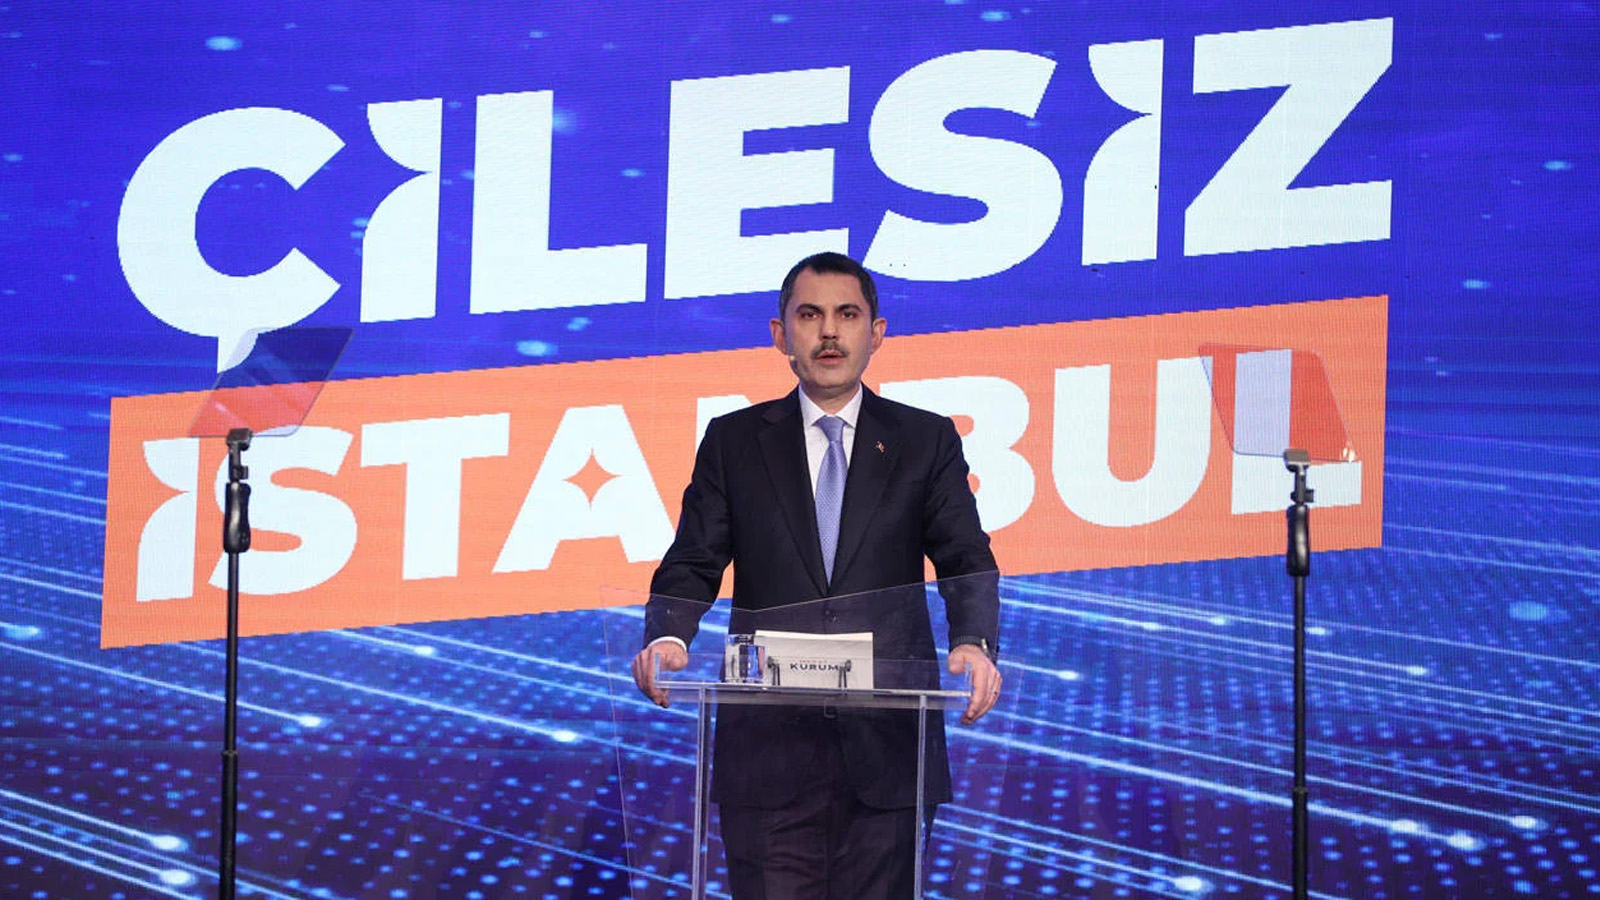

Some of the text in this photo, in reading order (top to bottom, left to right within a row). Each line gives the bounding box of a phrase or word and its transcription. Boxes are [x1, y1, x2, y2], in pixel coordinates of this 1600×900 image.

[117, 17, 1393, 373] ÇİLESİZ
[136, 349, 1362, 602] İSTABUL
[789, 662, 840, 671] KURUM
